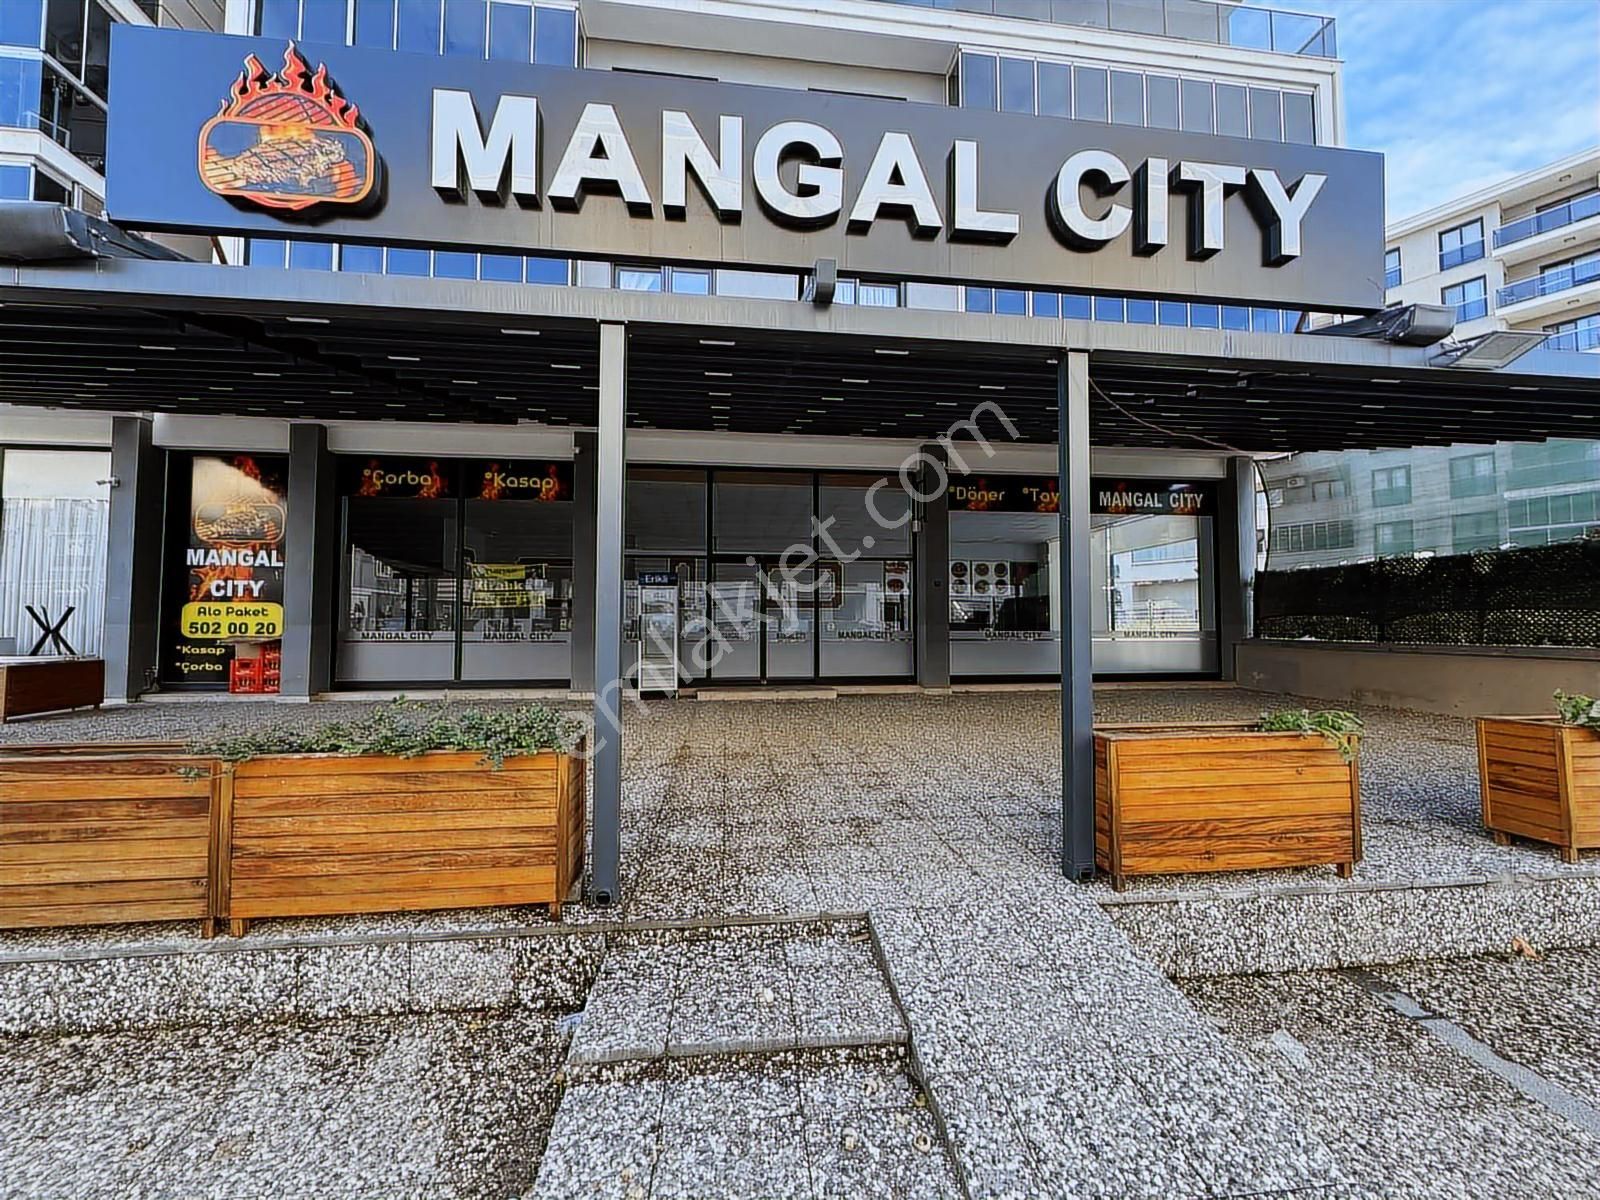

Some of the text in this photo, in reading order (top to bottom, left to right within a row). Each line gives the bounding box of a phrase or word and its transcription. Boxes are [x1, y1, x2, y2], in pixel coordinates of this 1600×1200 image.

[432, 88, 1328, 267] MANGAL CITY
[1099, 491, 1204, 509] MANGAL CITY
[186, 549, 284, 567] MANGAL
[210, 580, 265, 597] CITY
[197, 606, 269, 617] Alo Paket
[189, 622, 276, 635] 502 00 20
